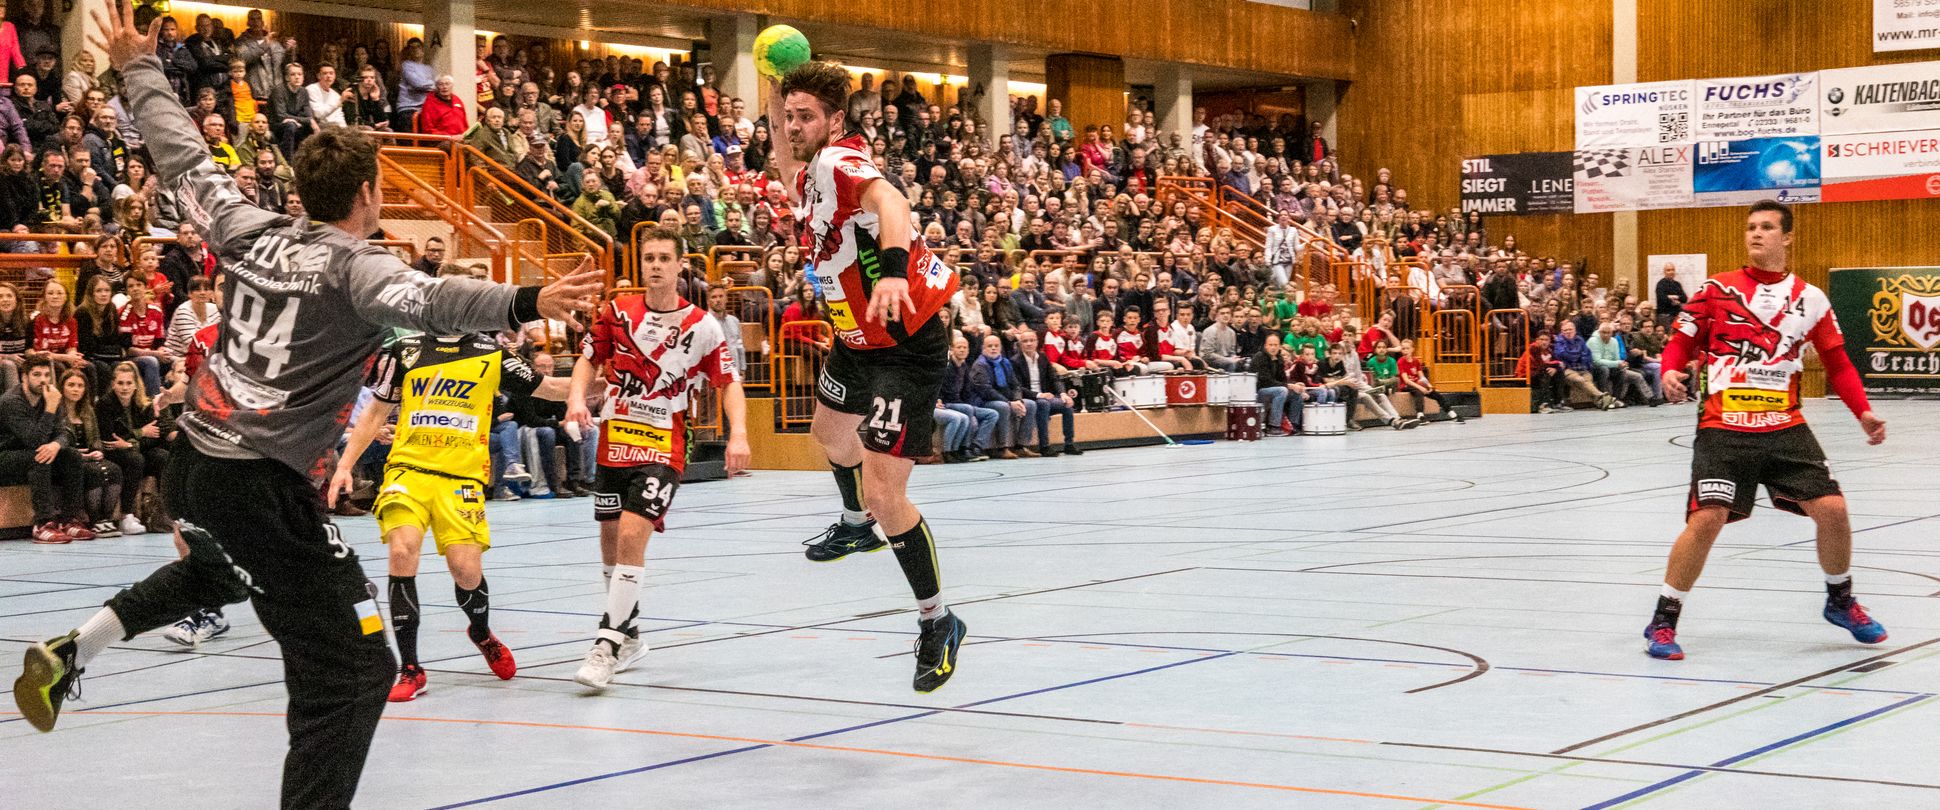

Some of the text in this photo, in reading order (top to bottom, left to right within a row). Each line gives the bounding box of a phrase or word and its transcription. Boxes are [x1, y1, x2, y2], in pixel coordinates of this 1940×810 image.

[430, 30, 442, 48] A
[1602, 90, 1688, 106] SPRINGTEC
[1704, 82, 1786, 101] FUCHS
[1854, 80, 1940, 105] KALTENBAC
[1718, 110, 1751, 119] Partner
[1753, 109, 1767, 118] für
[1769, 108, 1786, 116] das
[1789, 106, 1811, 115] Büro
[1714, 127, 1797, 137] www.bog-fuchs.de
[1638, 147, 1688, 165] ALEX
[1843, 138, 1939, 157] SCHRIEVER
[1461, 158, 1494, 174] STIL
[1461, 178, 1507, 194] SIEGT
[1461, 197, 1517, 214] IMMER
[1784, 295, 1805, 317] 14
[227, 280, 301, 379] 94
[664, 325, 695, 354] 34
[479, 361, 490, 378] 7
[1748, 367, 1787, 378] MAYWEG
[819, 374, 841, 397] ANZ
[1729, 394, 1784, 404] TURCK
[630, 401, 667, 416] MAYWEG
[869, 396, 902, 432] 21
[411, 413, 475, 431] timeout
[613, 426, 664, 442] TURCK
[642, 476, 673, 507] 34
[1701, 483, 1734, 495] MANZ
[595, 497, 617, 506] ANZ
